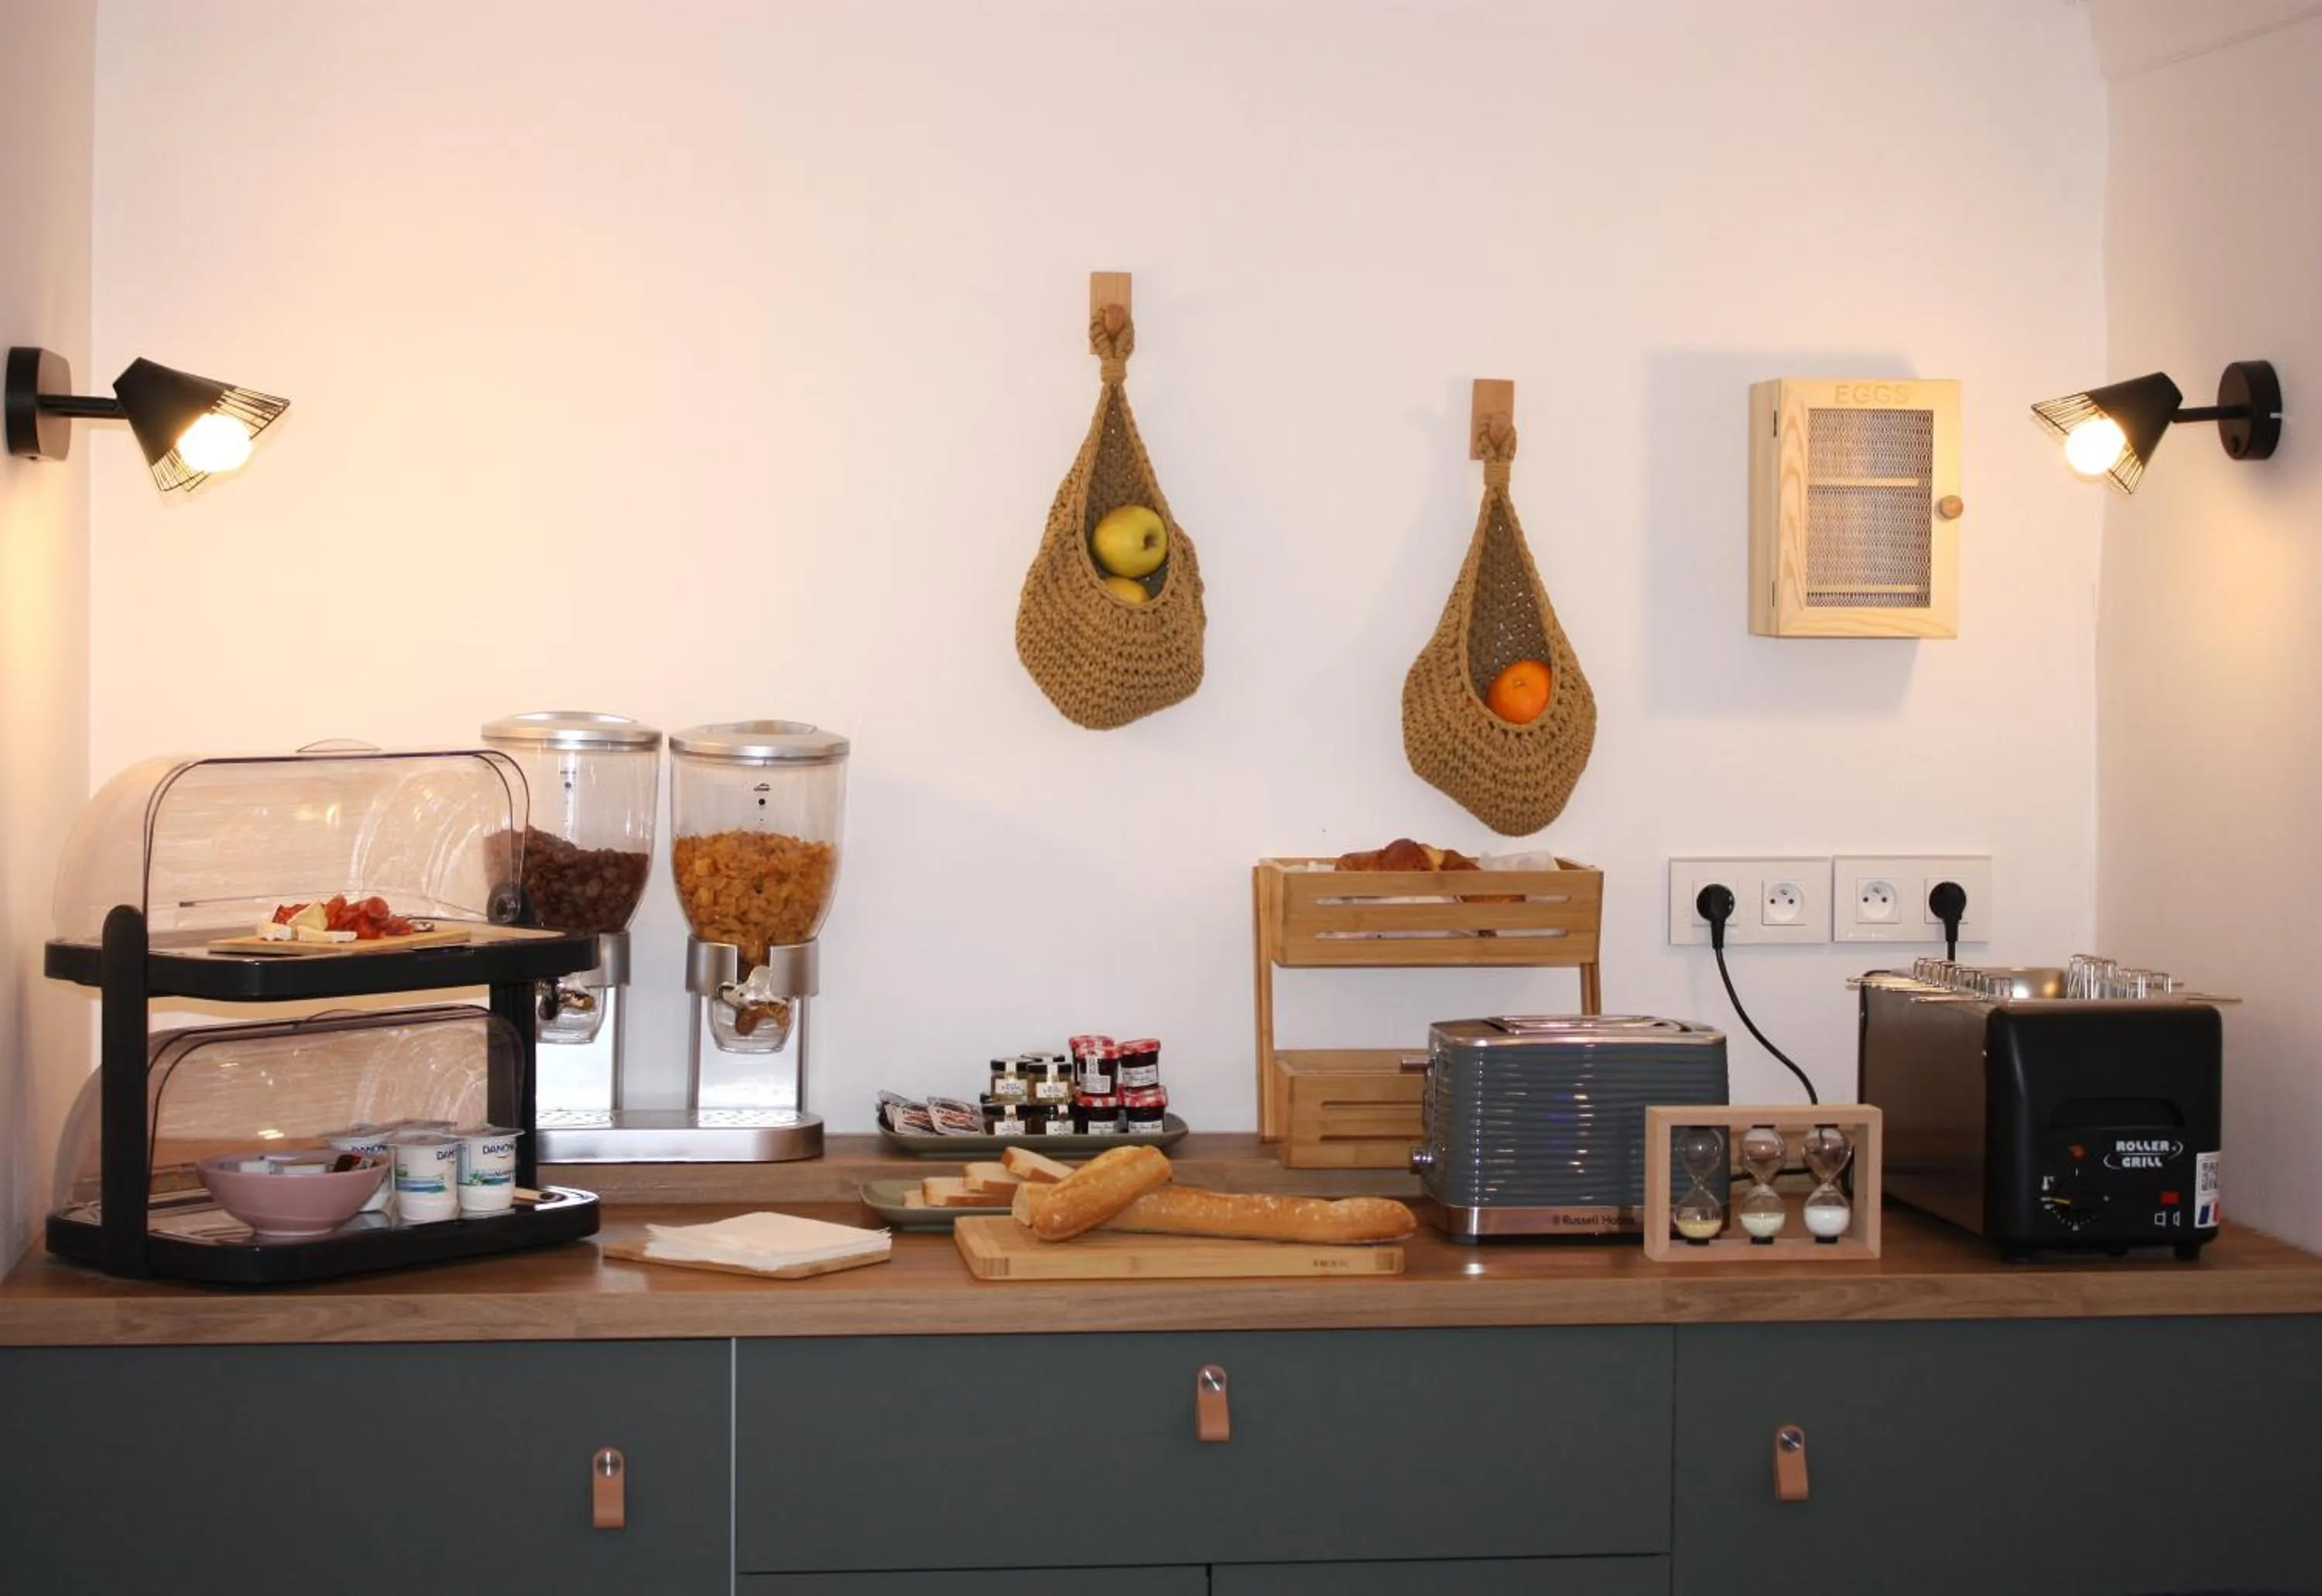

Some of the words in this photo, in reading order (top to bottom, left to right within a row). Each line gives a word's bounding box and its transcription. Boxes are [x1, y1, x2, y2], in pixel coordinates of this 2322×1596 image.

[1834, 385, 1909, 404] EGGS
[2115, 1140, 2170, 1152] ROLLER
[2122, 1156, 2163, 1168] GRILL
[1562, 1215, 1598, 1224] Russell
